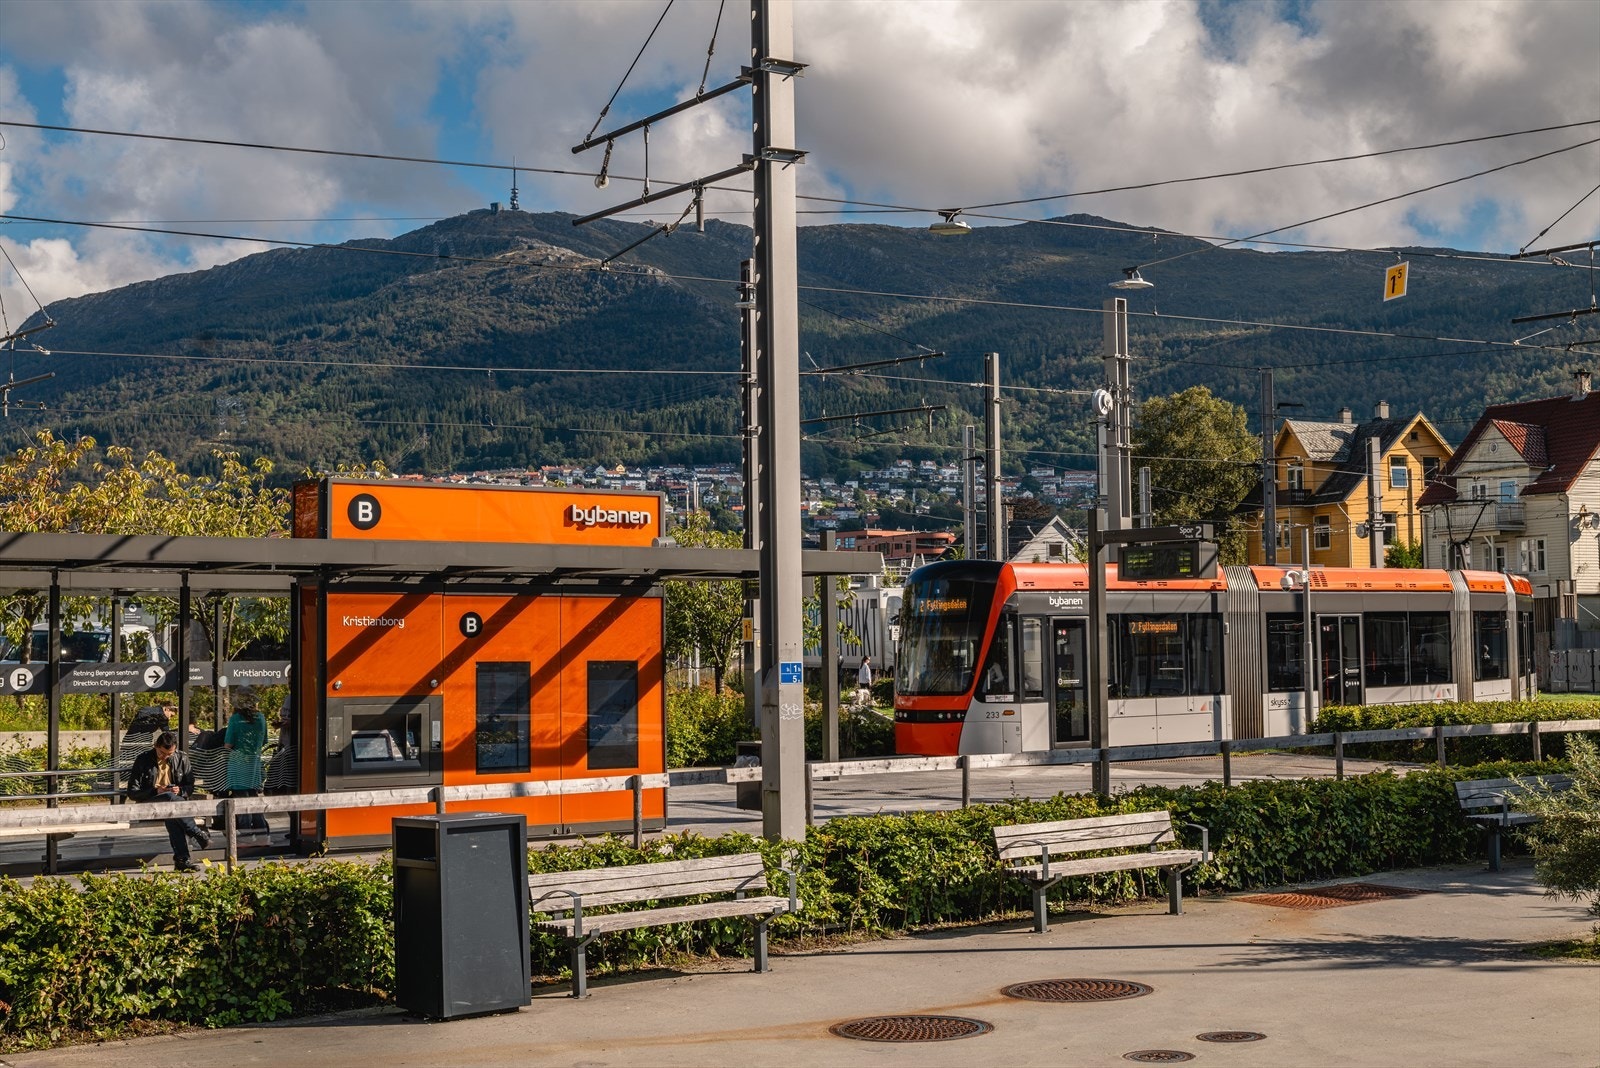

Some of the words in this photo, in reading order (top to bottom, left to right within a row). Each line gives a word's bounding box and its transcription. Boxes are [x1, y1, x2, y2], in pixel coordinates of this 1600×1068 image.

[358, 501, 373, 522] B
[572, 504, 651, 526] bybanen
[1179, 526, 1194, 535] Spor
[1195, 525, 1203, 539] 2
[1049, 596, 1083, 607] bybanen
[343, 616, 405, 629] Kristianborg
[466, 617, 477, 633] B
[1131, 621, 1136, 634] 2
[1138, 621, 1178, 633] Fyllingsdalen
[16, 673, 28, 687] B
[233, 668, 281, 679] Kristianborg
[1270, 697, 1287, 708] skyss
[985, 711, 999, 719] 233
